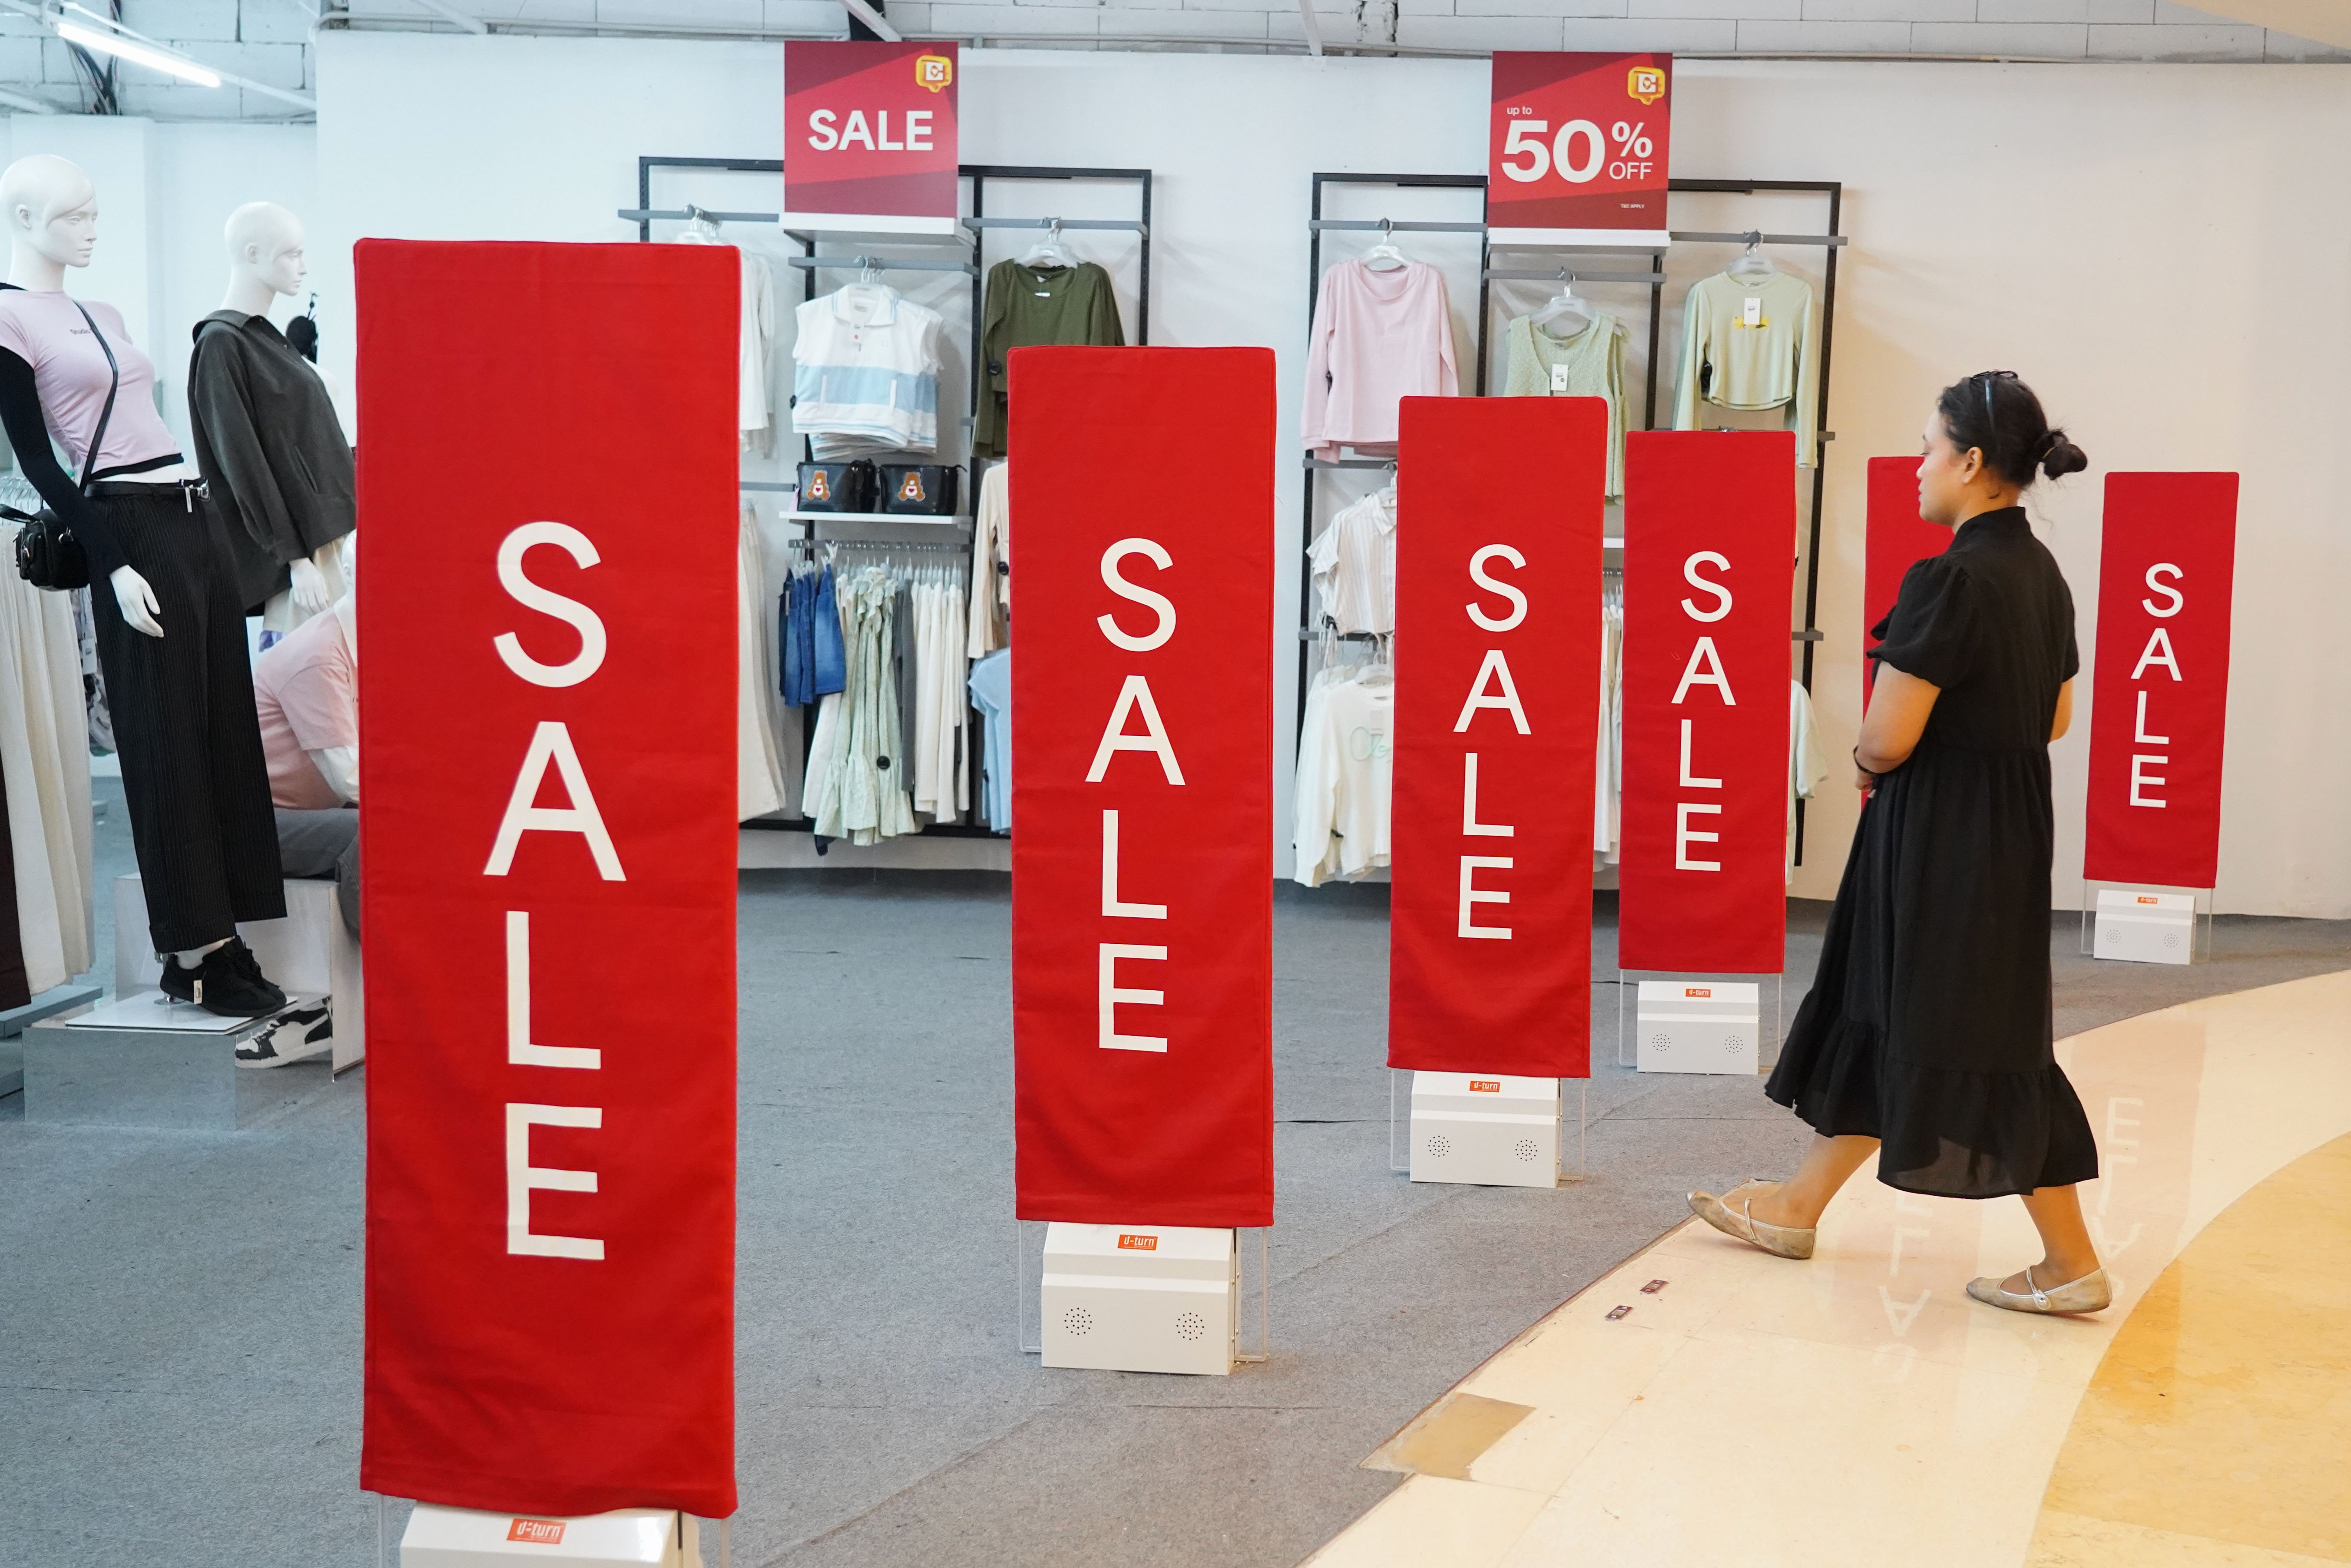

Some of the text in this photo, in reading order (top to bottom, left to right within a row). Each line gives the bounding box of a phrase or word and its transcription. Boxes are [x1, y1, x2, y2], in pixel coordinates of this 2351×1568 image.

[808, 109, 934, 151] SALE
[1507, 106, 1533, 116] up to
[1609, 162, 1653, 180] OFF
[1085, 538, 1186, 1053] SALE
[1453, 544, 1532, 939] SALE
[1671, 551, 1736, 871] SALE
[2129, 562, 2183, 808] SALE
[483, 521, 627, 1260] SALE
